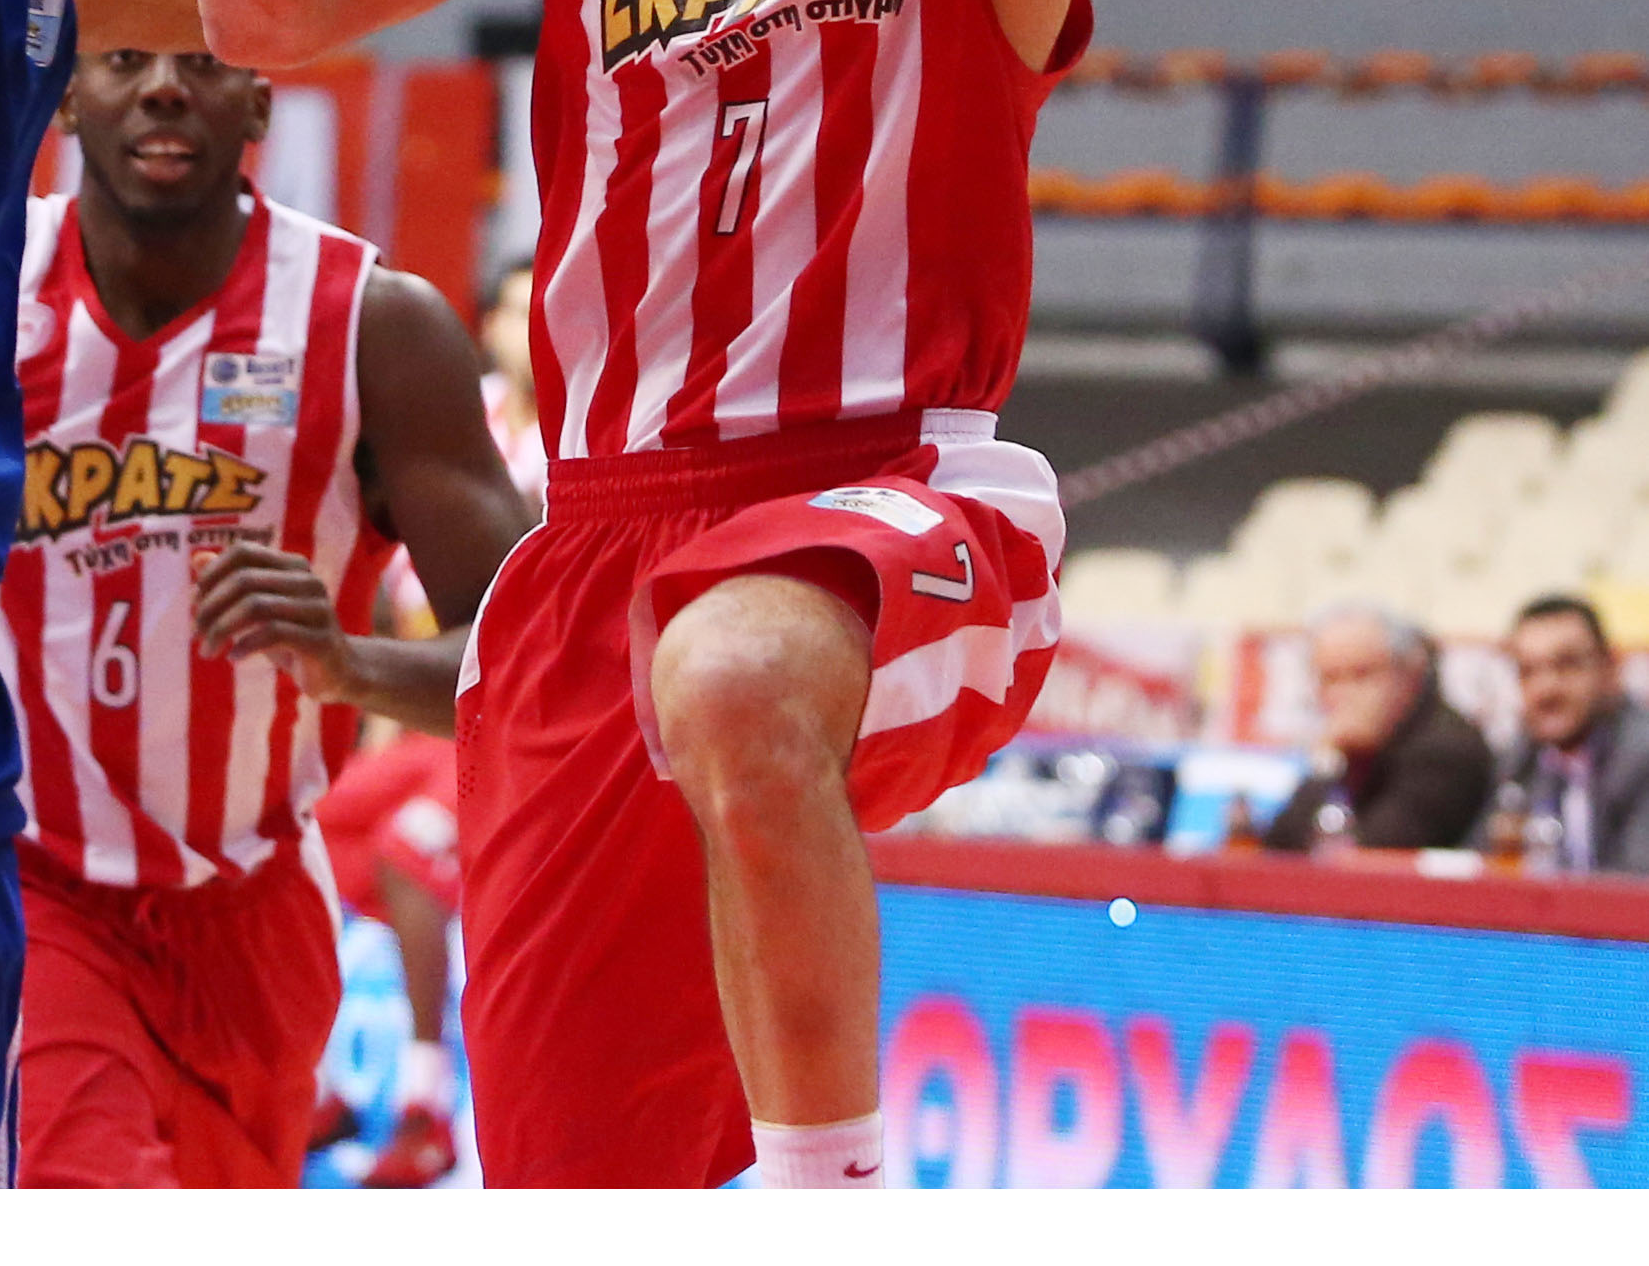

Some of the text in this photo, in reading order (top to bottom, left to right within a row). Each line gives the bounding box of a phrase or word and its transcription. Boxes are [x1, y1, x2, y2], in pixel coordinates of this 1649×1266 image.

[750, 2, 802, 39] στη
[715, 99, 770, 235] 7
[18, 438, 268, 543] ΚΡΑΤΣ
[911, 540, 975, 604] 7
[91, 599, 143, 710] 6
